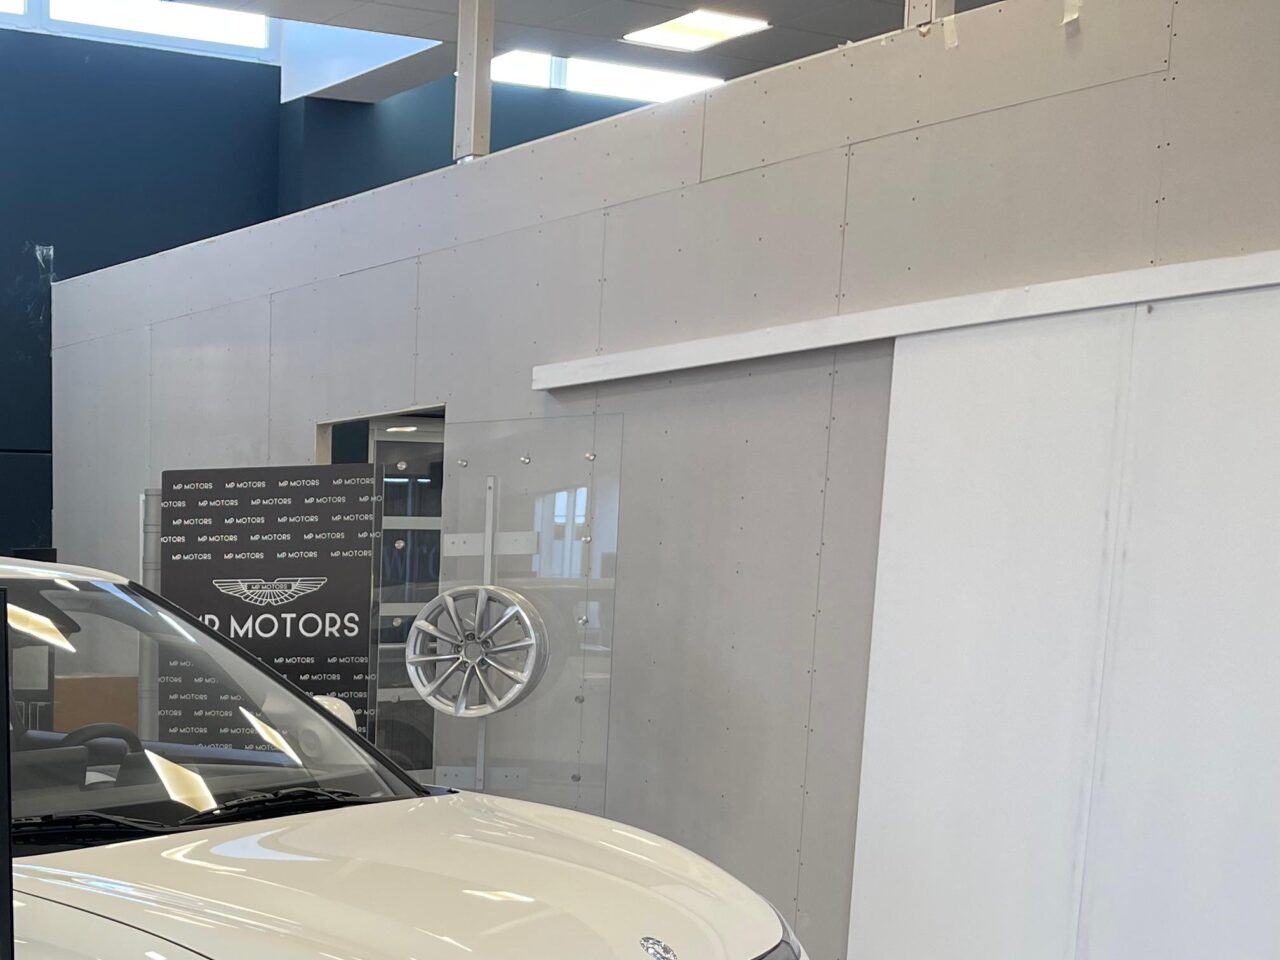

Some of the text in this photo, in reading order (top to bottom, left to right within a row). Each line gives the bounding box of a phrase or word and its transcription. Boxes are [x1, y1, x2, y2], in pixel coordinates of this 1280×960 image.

[344, 477, 375, 485] MOTORS
[235, 516, 265, 524] MOTORS
[343, 513, 374, 521] MOTORS
[198, 612, 360, 638] P MOTORS
